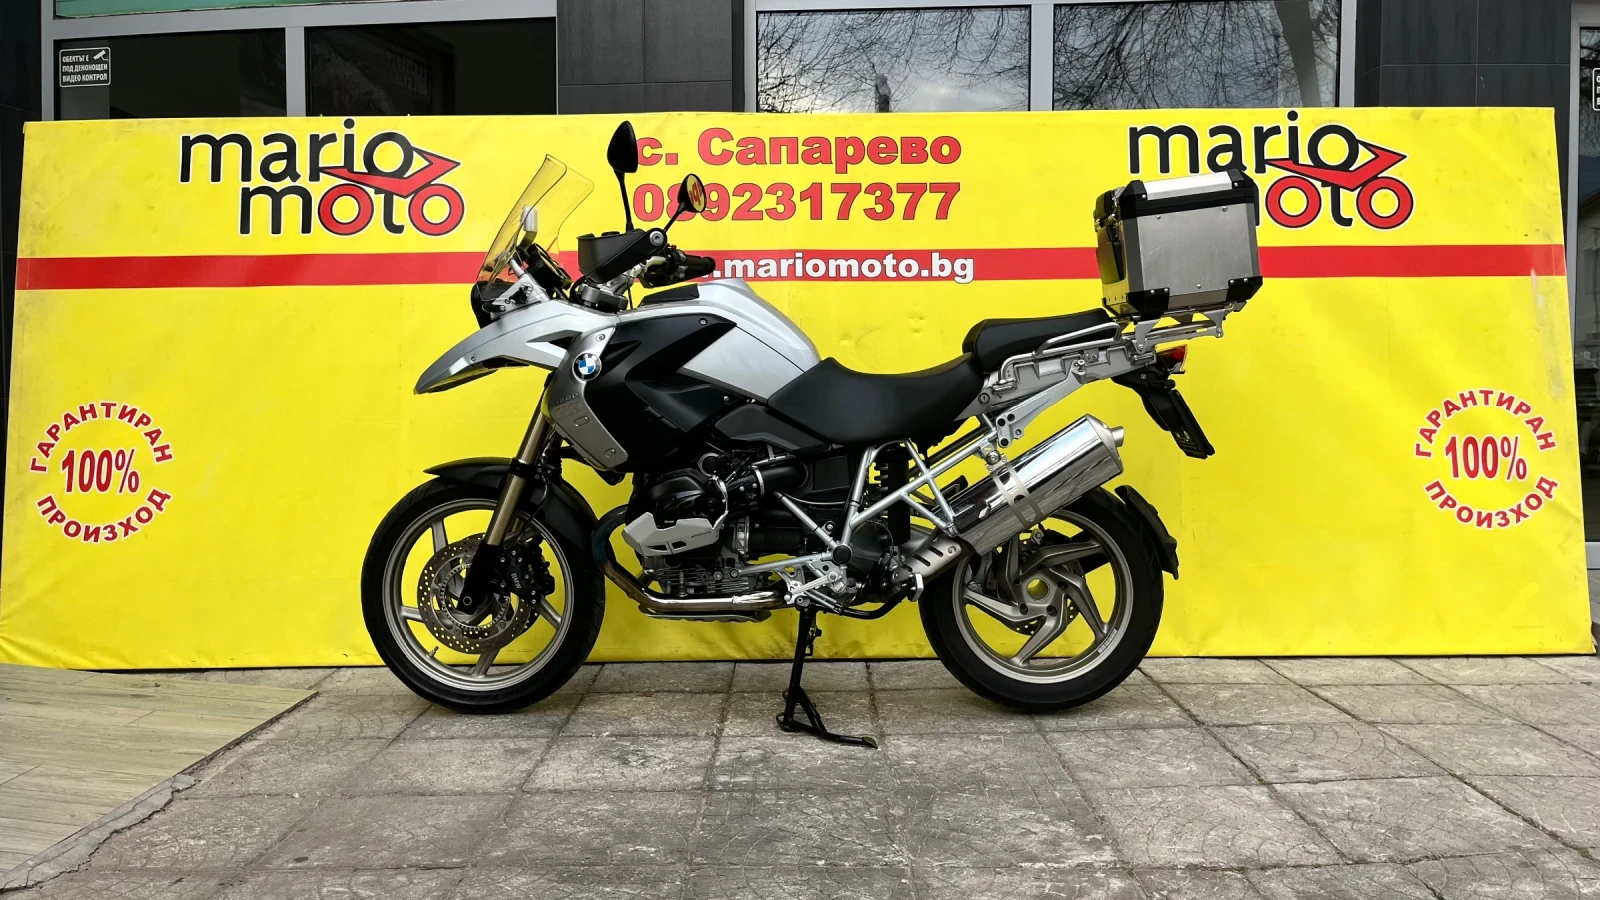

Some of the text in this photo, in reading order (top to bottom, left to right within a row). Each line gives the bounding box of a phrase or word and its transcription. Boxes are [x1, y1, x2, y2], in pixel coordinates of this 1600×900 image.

[62, 73, 107, 83] ВИДЕО КОНТРОЛ
[74, 64, 107, 72] ДЕНОНОЩЕН
[180, 118, 414, 182] mario
[637, 127, 962, 174] с. Сапарево
[1128, 110, 1359, 174] mario
[240, 183, 464, 236] moto
[633, 182, 961, 222] 0892317377
[702, 252, 974, 283] .mariomoto.bg
[30, 402, 173, 472] ГАРАНТИРАН
[1415, 390, 1556, 457] ГАРАНТИРАН
[61, 448, 140, 493] 100%
[1445, 436, 1527, 480] 100%
[37, 489, 172, 542] ПРОИЗХОД
[1425, 476, 1558, 528] ПРОИЗХОД
[510, 572, 522, 589] BMW
